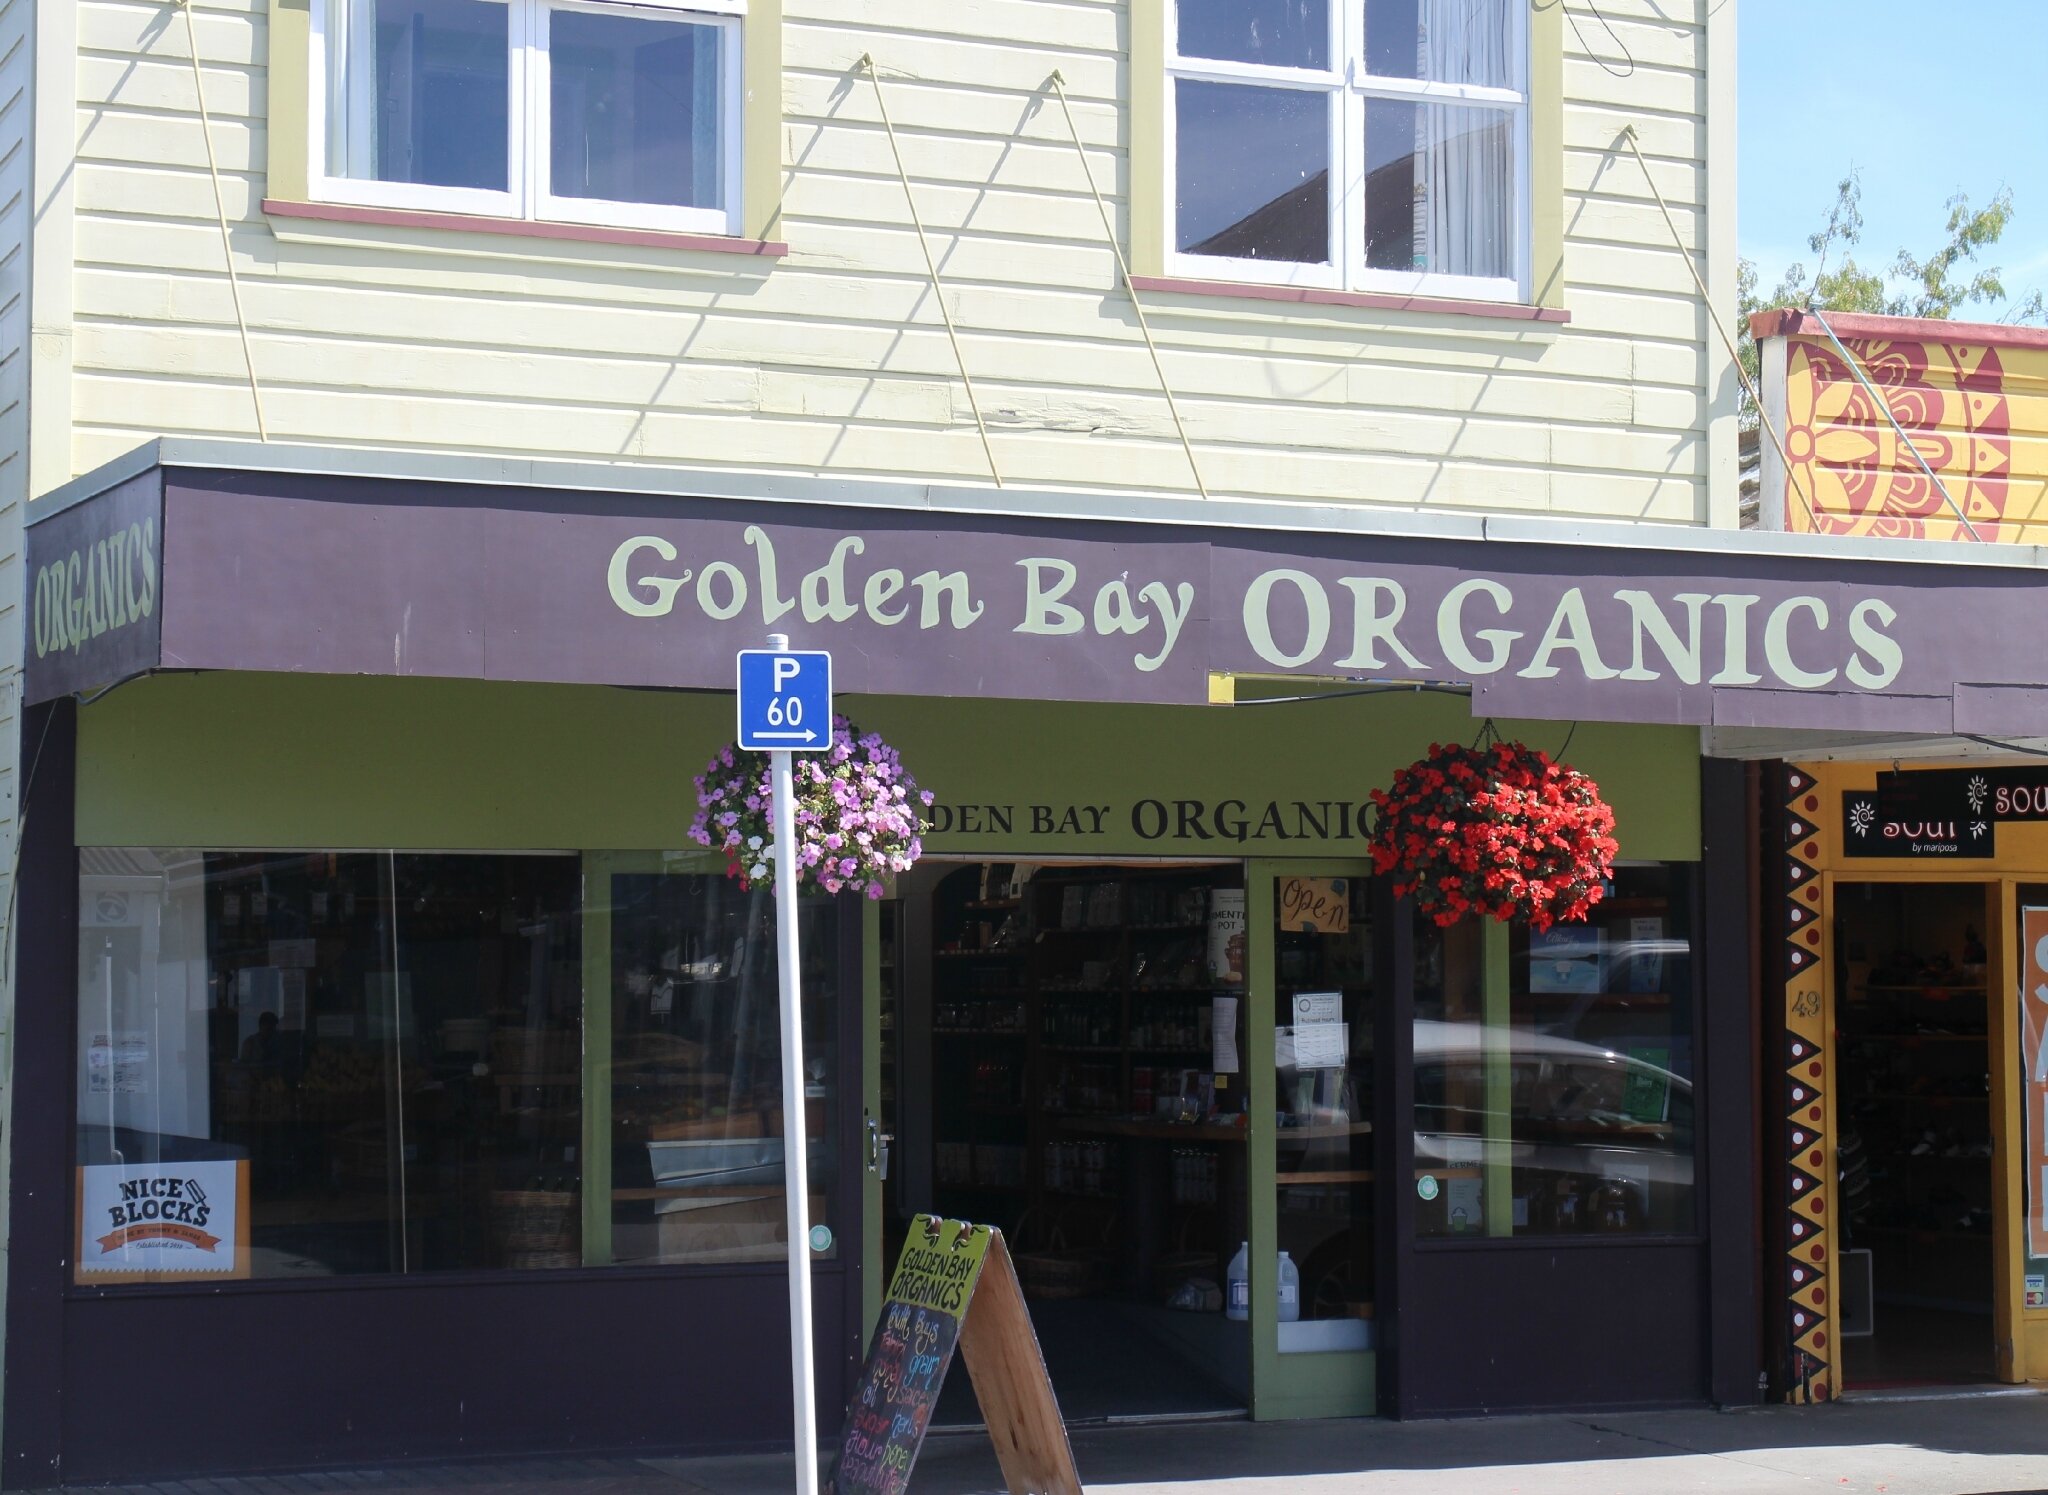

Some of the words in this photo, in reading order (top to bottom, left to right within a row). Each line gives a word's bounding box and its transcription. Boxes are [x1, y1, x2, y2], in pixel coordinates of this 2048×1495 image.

[35, 517, 155, 659] ORGANICS
[607, 525, 984, 629] Golden
[1012, 557, 1195, 671] Bay
[1243, 569, 1904, 689] ORGANICS
[774, 658, 800, 692] P
[767, 696, 802, 726] 60
[1029, 805, 1110, 834] BAY
[1131, 800, 1378, 843] ORGANIC
[1912, 842, 1922, 853] by
[1924, 843, 1958, 854] mariposa
[1217, 921, 1237, 930] POT
[1792, 991, 1819, 1017] 49
[119, 1178, 183, 1201] NICE
[108, 1200, 210, 1228] BLOCKS
[902, 1247, 948, 1277] GOLDEN
[947, 1254, 975, 1281] BAY
[891, 1271, 964, 1311] ORGANICS
